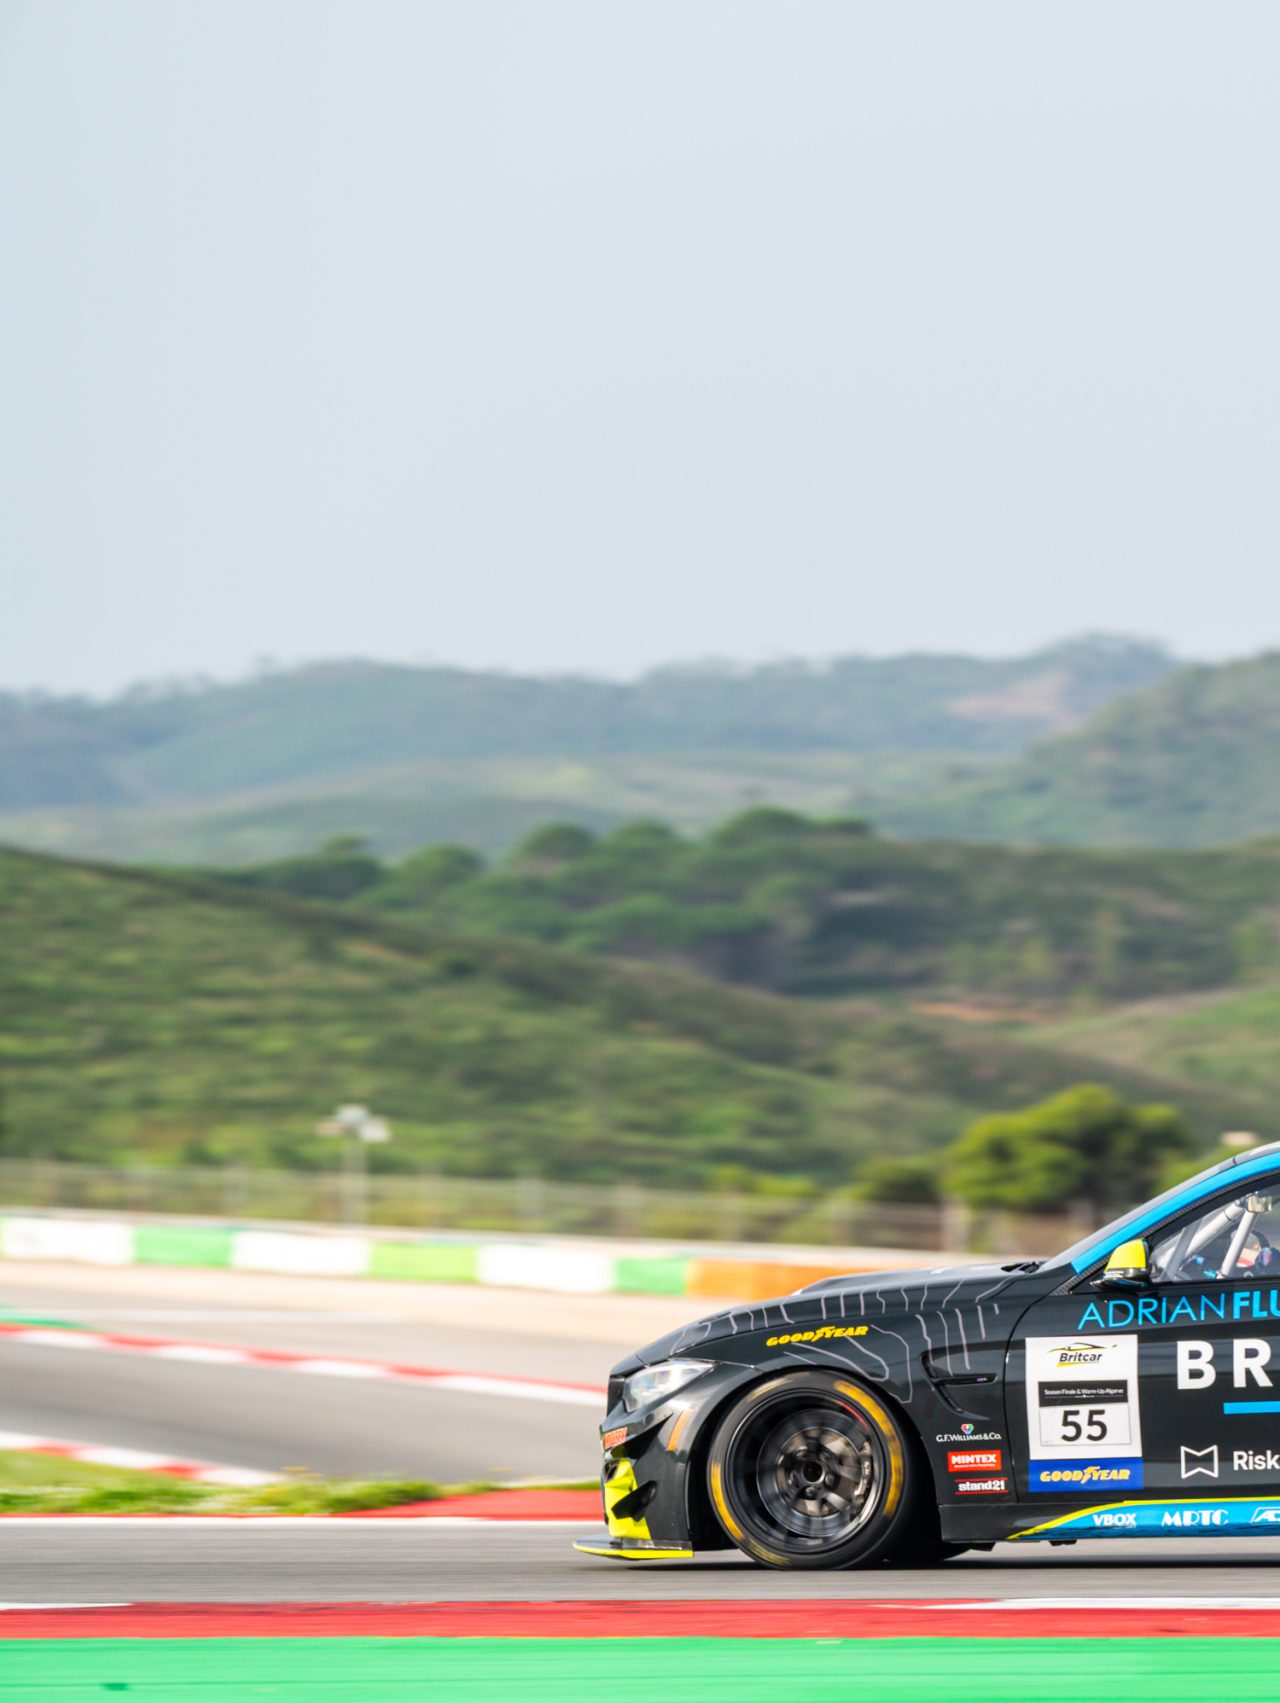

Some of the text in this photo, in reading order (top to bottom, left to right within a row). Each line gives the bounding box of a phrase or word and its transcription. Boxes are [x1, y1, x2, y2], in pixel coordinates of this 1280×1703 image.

[766, 1326, 869, 1346] GOODYEAR
[1059, 1352, 1102, 1363] Britcar
[1061, 1409, 1107, 1442] 55
[951, 1454, 997, 1464] MINTEX
[1233, 1450, 1280, 1471] Risk
[1040, 1466, 1131, 1484] GOODYEAR
[958, 1480, 1005, 1491] stand21
[1092, 1513, 1137, 1526] VBOX
